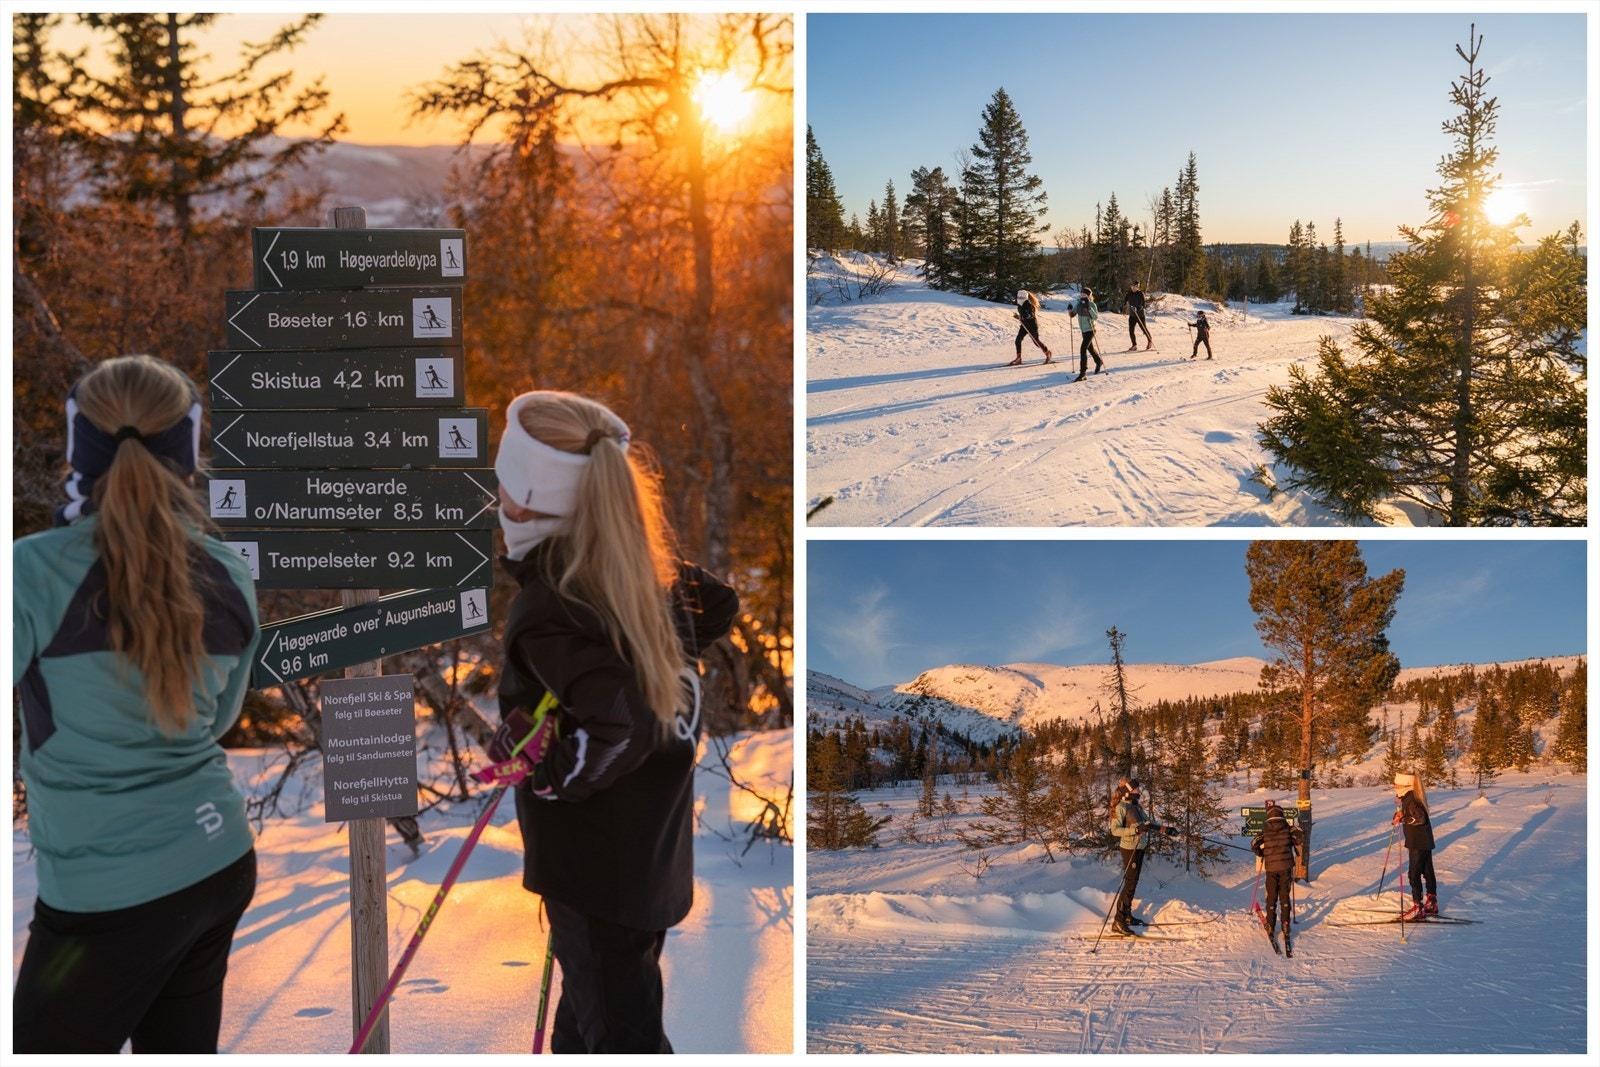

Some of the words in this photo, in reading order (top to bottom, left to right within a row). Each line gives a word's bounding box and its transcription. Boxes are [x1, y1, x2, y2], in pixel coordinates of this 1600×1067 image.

[280, 250, 298, 270] 1,9
[306, 250, 325, 268] km
[340, 249, 437, 271] Høgevardeløypa
[268, 312, 333, 328] Bøseter
[345, 312, 367, 329] 1,6
[378, 311, 404, 327] km
[251, 371, 321, 389] Skistua
[333, 370, 363, 389] 4,2
[375, 370, 404, 387] km
[246, 431, 353, 450] Norefjellstua
[364, 431, 391, 449] 3,4
[402, 431, 428, 447] km
[306, 478, 407, 498] Høgevarde
[254, 503, 382, 520] o/Narumseter
[393, 503, 423, 521] 8,5
[435, 503, 463, 520] km
[268, 552, 377, 572] Tempelseter
[387, 551, 415, 569] 9,2
[426, 551, 452, 567] km
[279, 624, 347, 653] Høgevarde
[353, 616, 380, 635] over
[385, 599, 456, 626] Augunshaug
[281, 656, 302, 676] 9,6
[309, 652, 328, 667] km
[324, 693, 365, 705] Norefjell
[368, 691, 382, 702] Ski
[384, 691, 392, 700] &
[393, 690, 412, 701] Spa
[335, 710, 352, 720] følg
[354, 709, 363, 718] til
[328, 733, 412, 748] Mountainlodge
[327, 754, 344, 764] følg
[346, 752, 355, 762] til
[356, 749, 414, 761] Sandumseter
[333, 776, 408, 790] NorefjellHytta
[341, 796, 359, 806] følg
[360, 794, 369, 803] til
[371, 792, 402, 802] Skistua
